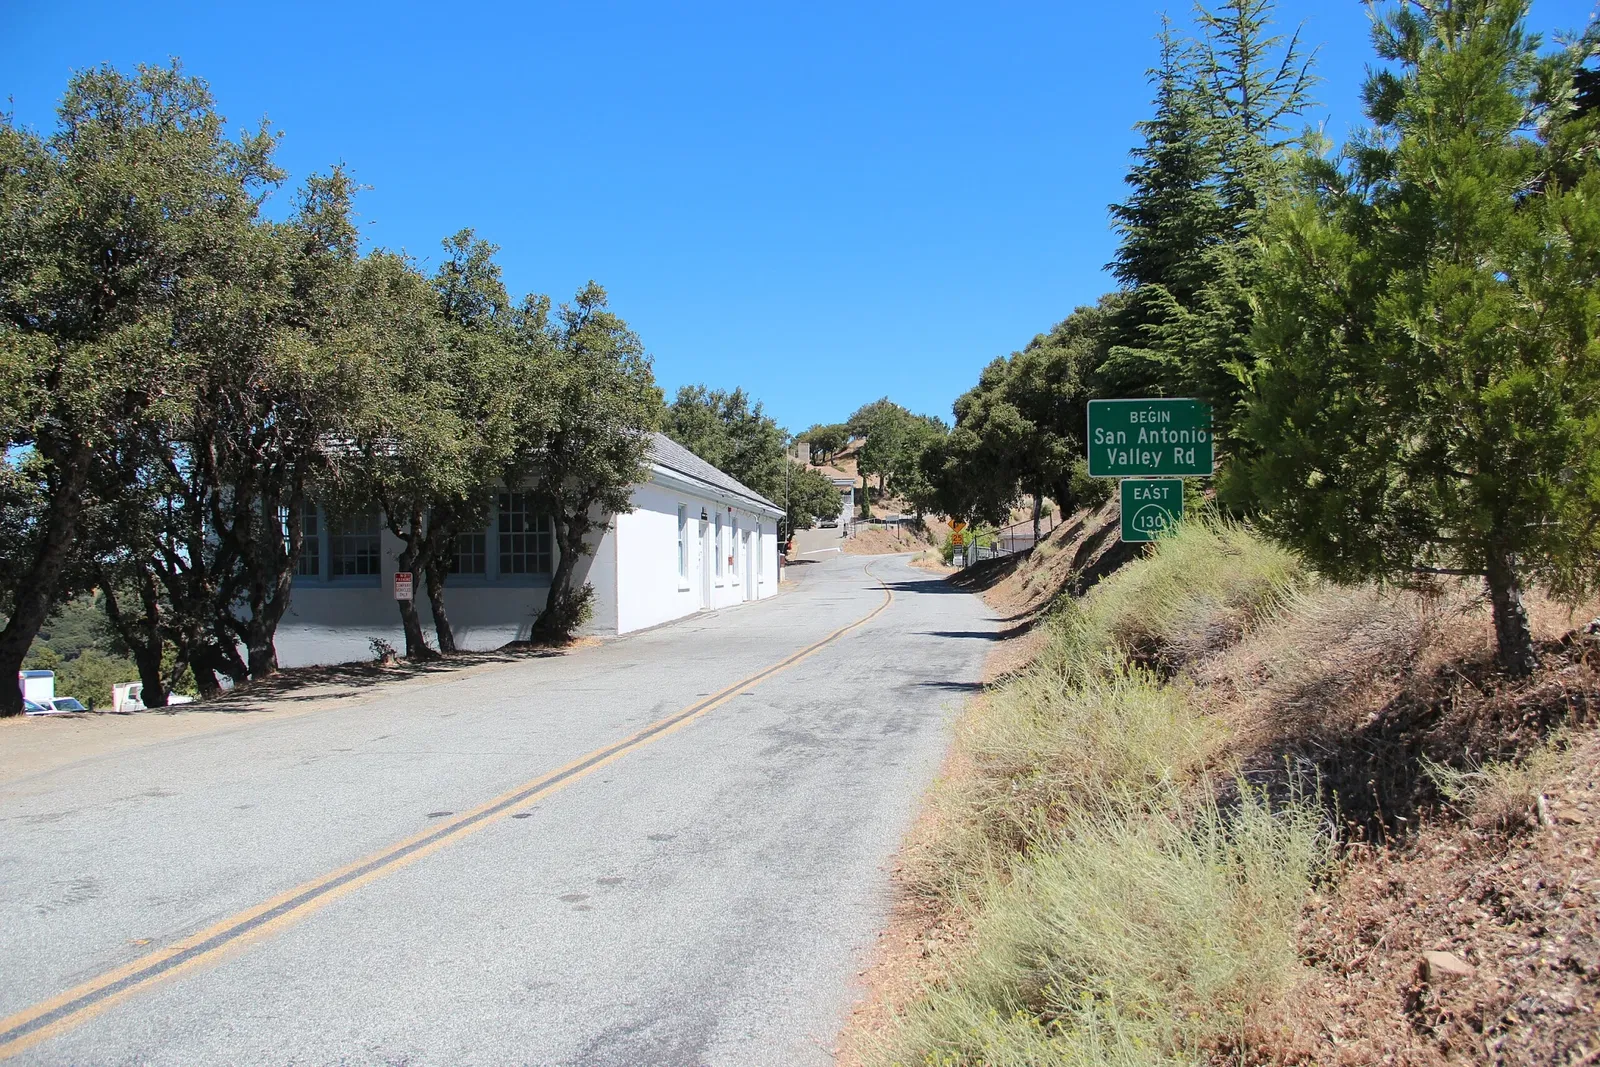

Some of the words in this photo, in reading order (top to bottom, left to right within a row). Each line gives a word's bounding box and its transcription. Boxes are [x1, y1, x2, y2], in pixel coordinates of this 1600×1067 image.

[1130, 411, 1170, 423] BEGIN
[1095, 428, 1126, 444] San
[1138, 427, 1206, 443] Antonio
[1107, 448, 1162, 468] Valley
[1174, 447, 1195, 464] Rd
[1134, 488, 1169, 500] EAST
[1140, 515, 1163, 528] 130
